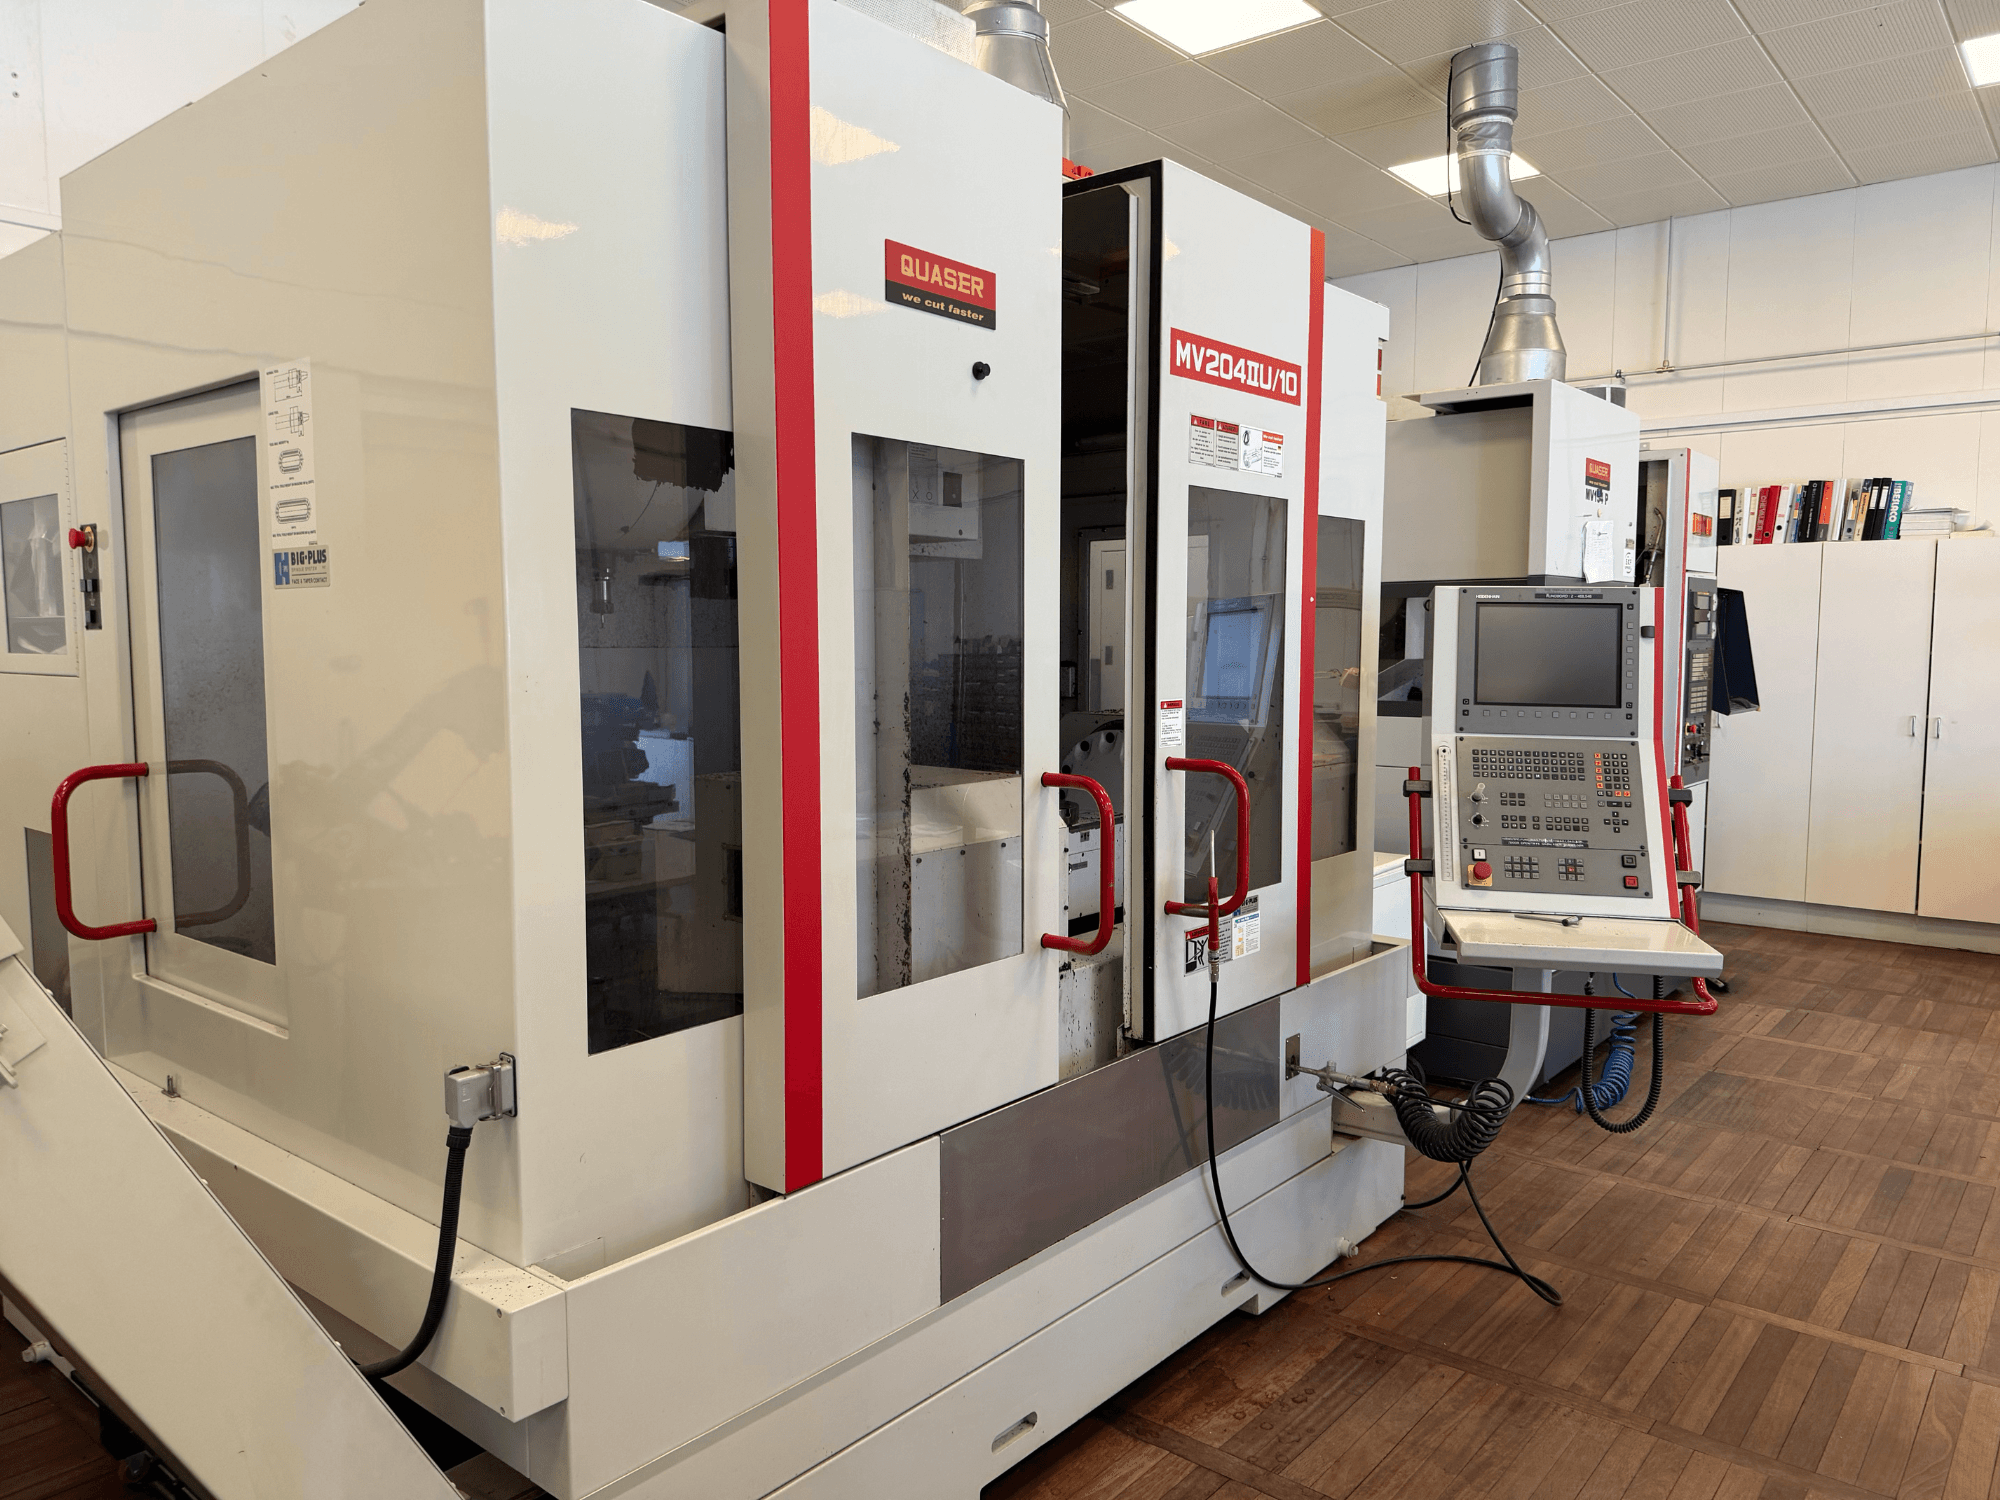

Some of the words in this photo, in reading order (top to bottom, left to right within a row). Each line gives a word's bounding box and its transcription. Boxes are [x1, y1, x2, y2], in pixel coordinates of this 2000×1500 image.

[901, 254, 984, 298] QUASER
[902, 292, 921, 304] we
[924, 299, 945, 311] cut
[948, 304, 984, 321] faster
